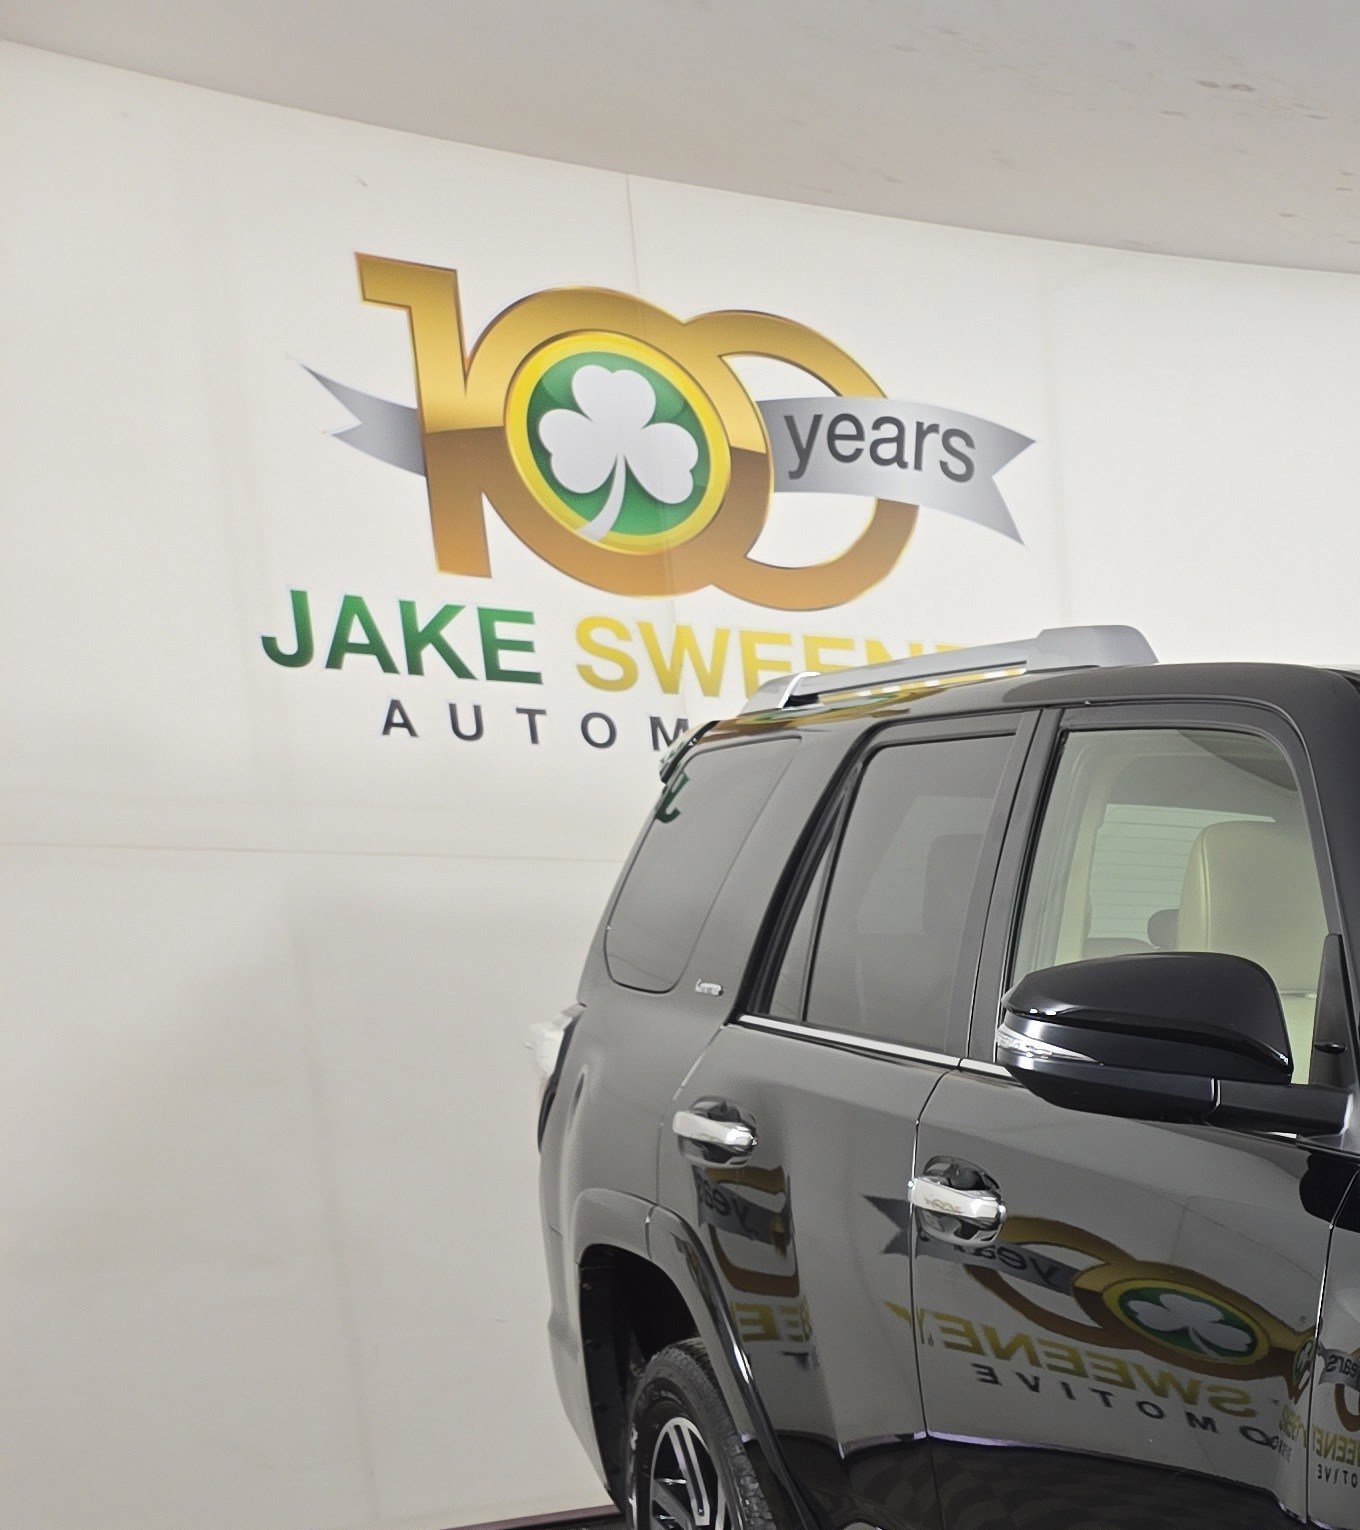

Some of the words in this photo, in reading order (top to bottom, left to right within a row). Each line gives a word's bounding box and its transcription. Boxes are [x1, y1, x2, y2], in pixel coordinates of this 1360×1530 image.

[355, 252, 918, 611] 100
[784, 412, 977, 484] years
[261, 588, 543, 686] JAKE
[382, 699, 690, 751] AUTOM
